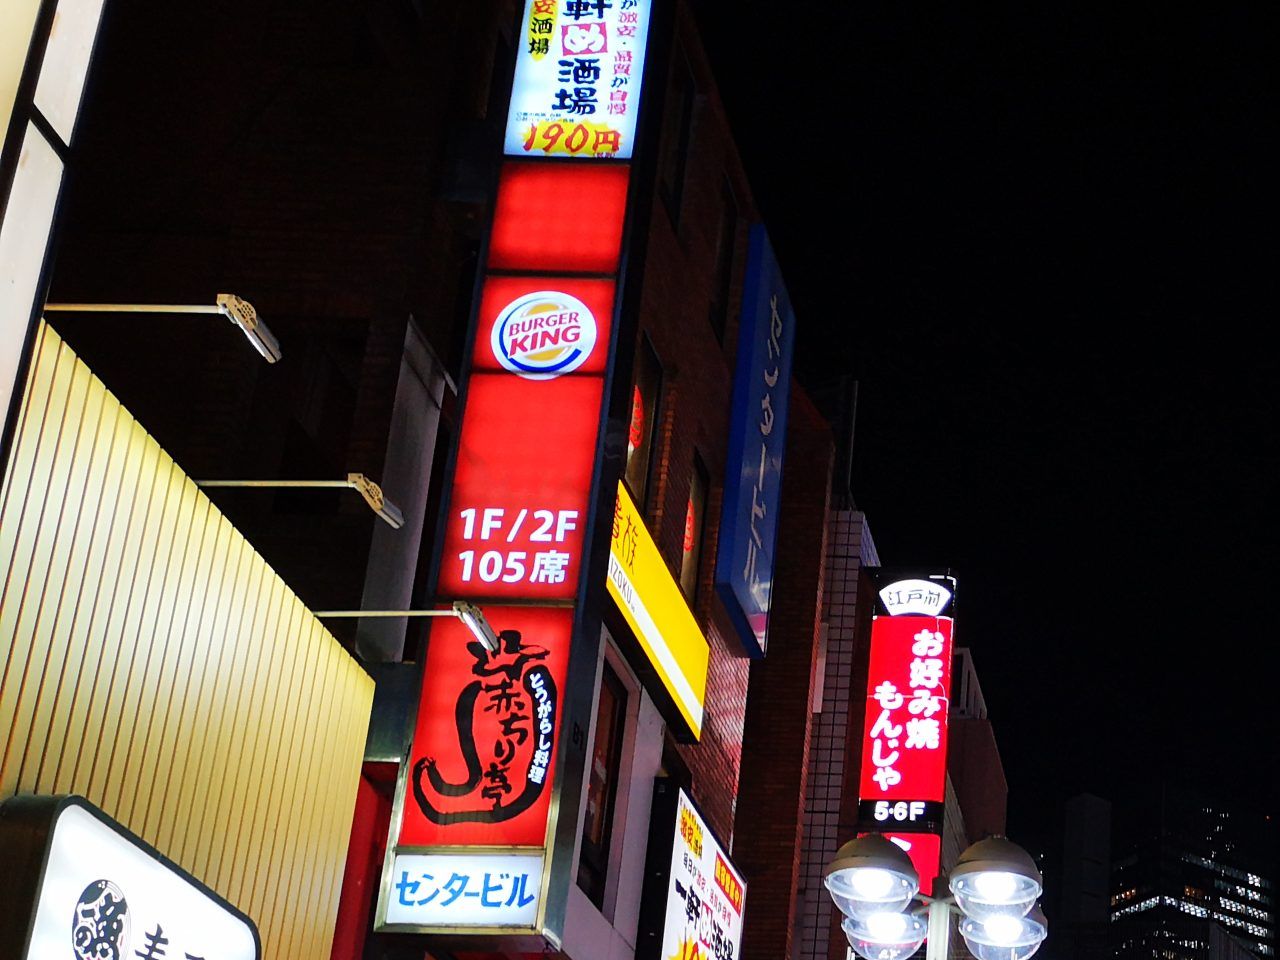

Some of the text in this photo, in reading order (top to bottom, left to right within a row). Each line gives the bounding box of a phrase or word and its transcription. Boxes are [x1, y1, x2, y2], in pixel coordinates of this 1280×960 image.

[523, 123, 622, 152] 190円
[508, 311, 579, 338] BURGER
[508, 326, 581, 360] KING
[458, 549, 570, 585] 105席
[906, 628, 944, 750] お好み焼
[528, 673, 553, 784] とうがらし料理
[869, 680, 903, 792] もんじゃ
[395, 870, 536, 910] センタービル
